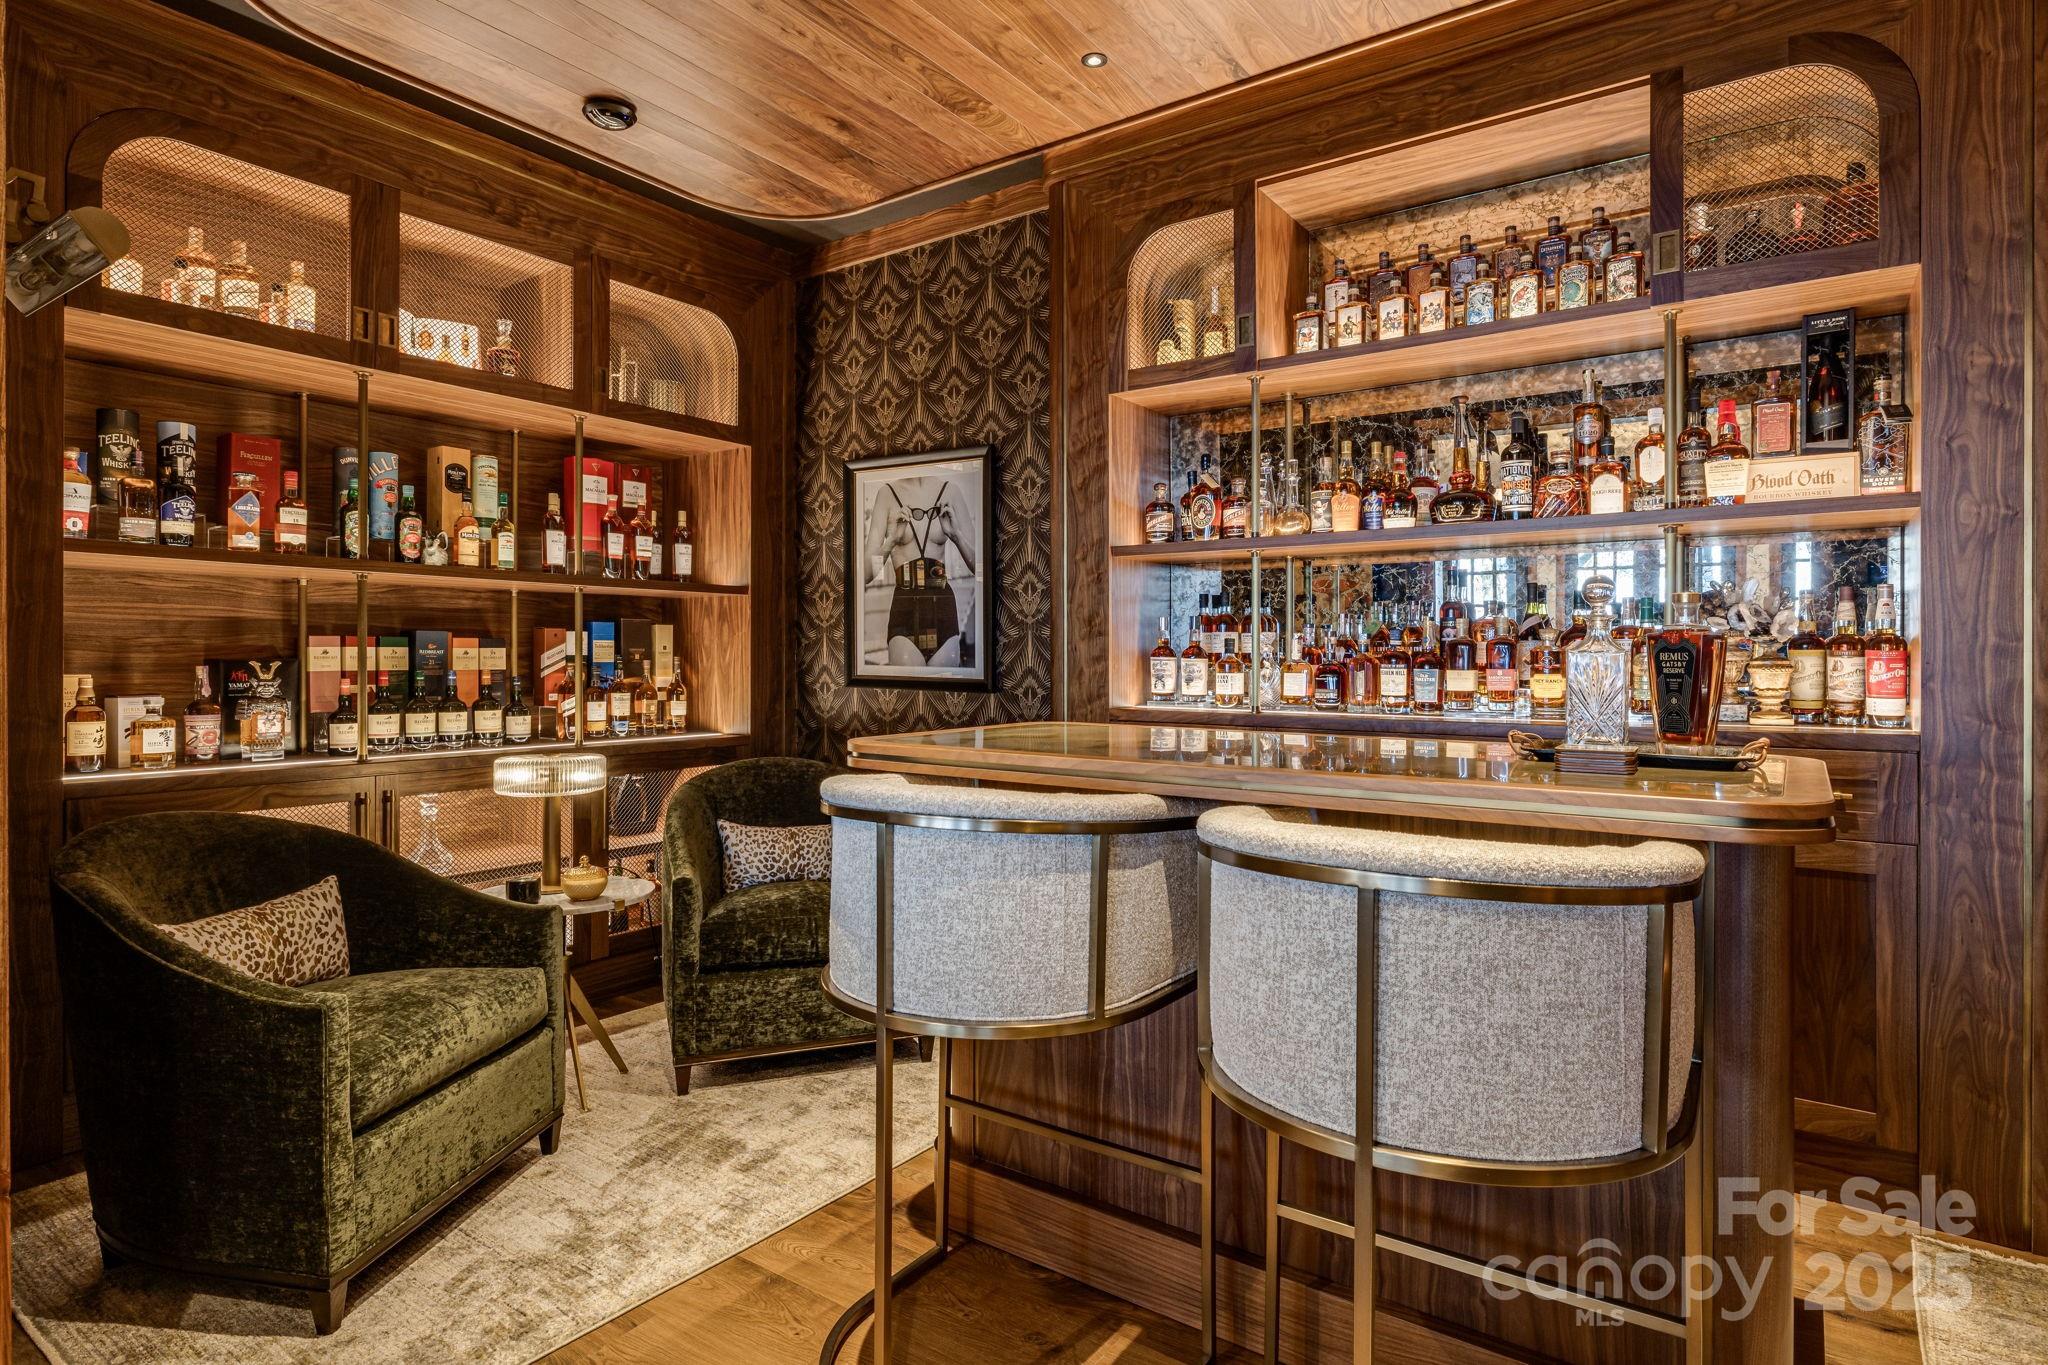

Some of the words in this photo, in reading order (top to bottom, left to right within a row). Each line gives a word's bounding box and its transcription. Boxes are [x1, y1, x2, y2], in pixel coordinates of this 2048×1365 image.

[160, 444, 196, 460] TEELIN
[101, 457, 131, 469] WHISK
[1501, 479, 1532, 491] ENNESSEE
[1750, 472, 1793, 492] Blood
[1797, 469, 1835, 487] Oath
[1794, 489, 1833, 498] WHISKEY
[1659, 652, 1689, 660] REMUS
